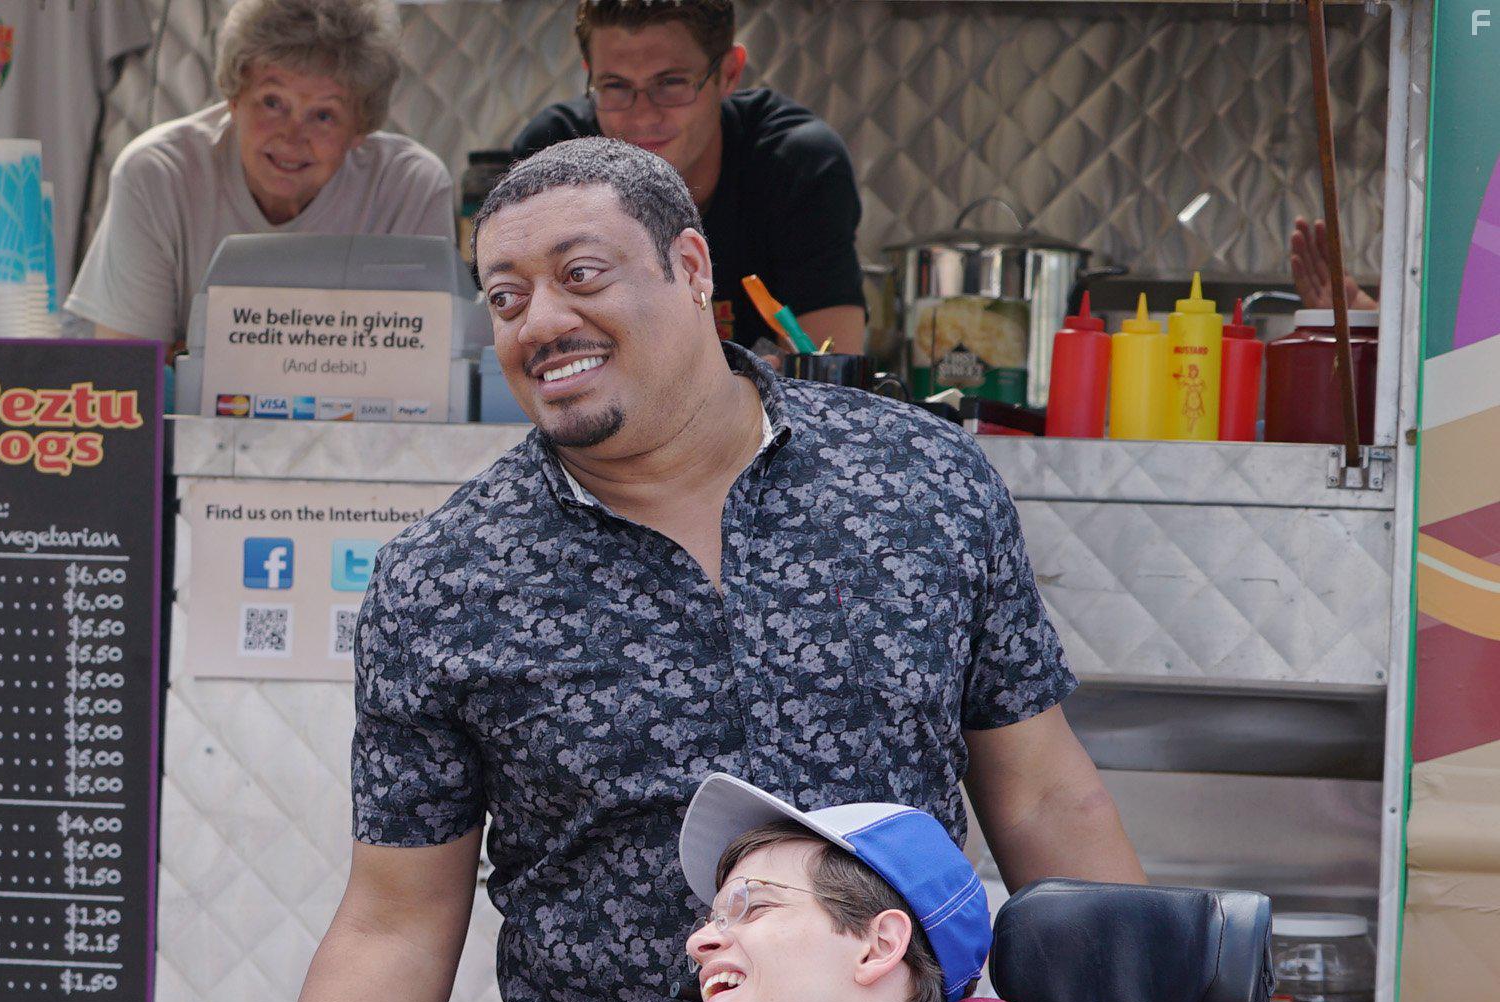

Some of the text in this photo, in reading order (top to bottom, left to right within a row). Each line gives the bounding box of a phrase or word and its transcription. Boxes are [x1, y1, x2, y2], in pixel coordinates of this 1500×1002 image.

[232, 308, 423, 335] We believe in giving
[229, 328, 282, 346] credit
[288, 330, 347, 347] where
[383, 332, 425, 349] due.
[283, 357, 367, 376] (And debit.)
[259, 400, 287, 410] VISA
[206, 504, 243, 521] Find
[247, 508, 266, 521] us
[271, 508, 293, 521] on
[297, 505, 325, 522] the
[0, 524, 120, 554] vegetarian
[65, 562, 126, 588] $6.00
[63, 588, 124, 614] $6.00
[68, 614, 125, 640] $5.50
[65, 640, 123, 667] $5.50
[66, 666, 125, 692] $5.00
[64, 692, 123, 718] $5.00
[64, 718, 123, 744] $5.00
[65, 744, 124, 770] $5.00
[64, 770, 124, 797] $5.00
[57, 810, 123, 837] $4.00
[63, 836, 122, 862] $5.00
[64, 862, 122, 890] $1.50
[65, 902, 122, 929] $1.20
[64, 928, 121, 955] $2.15
[60, 968, 118, 996] $1.50
